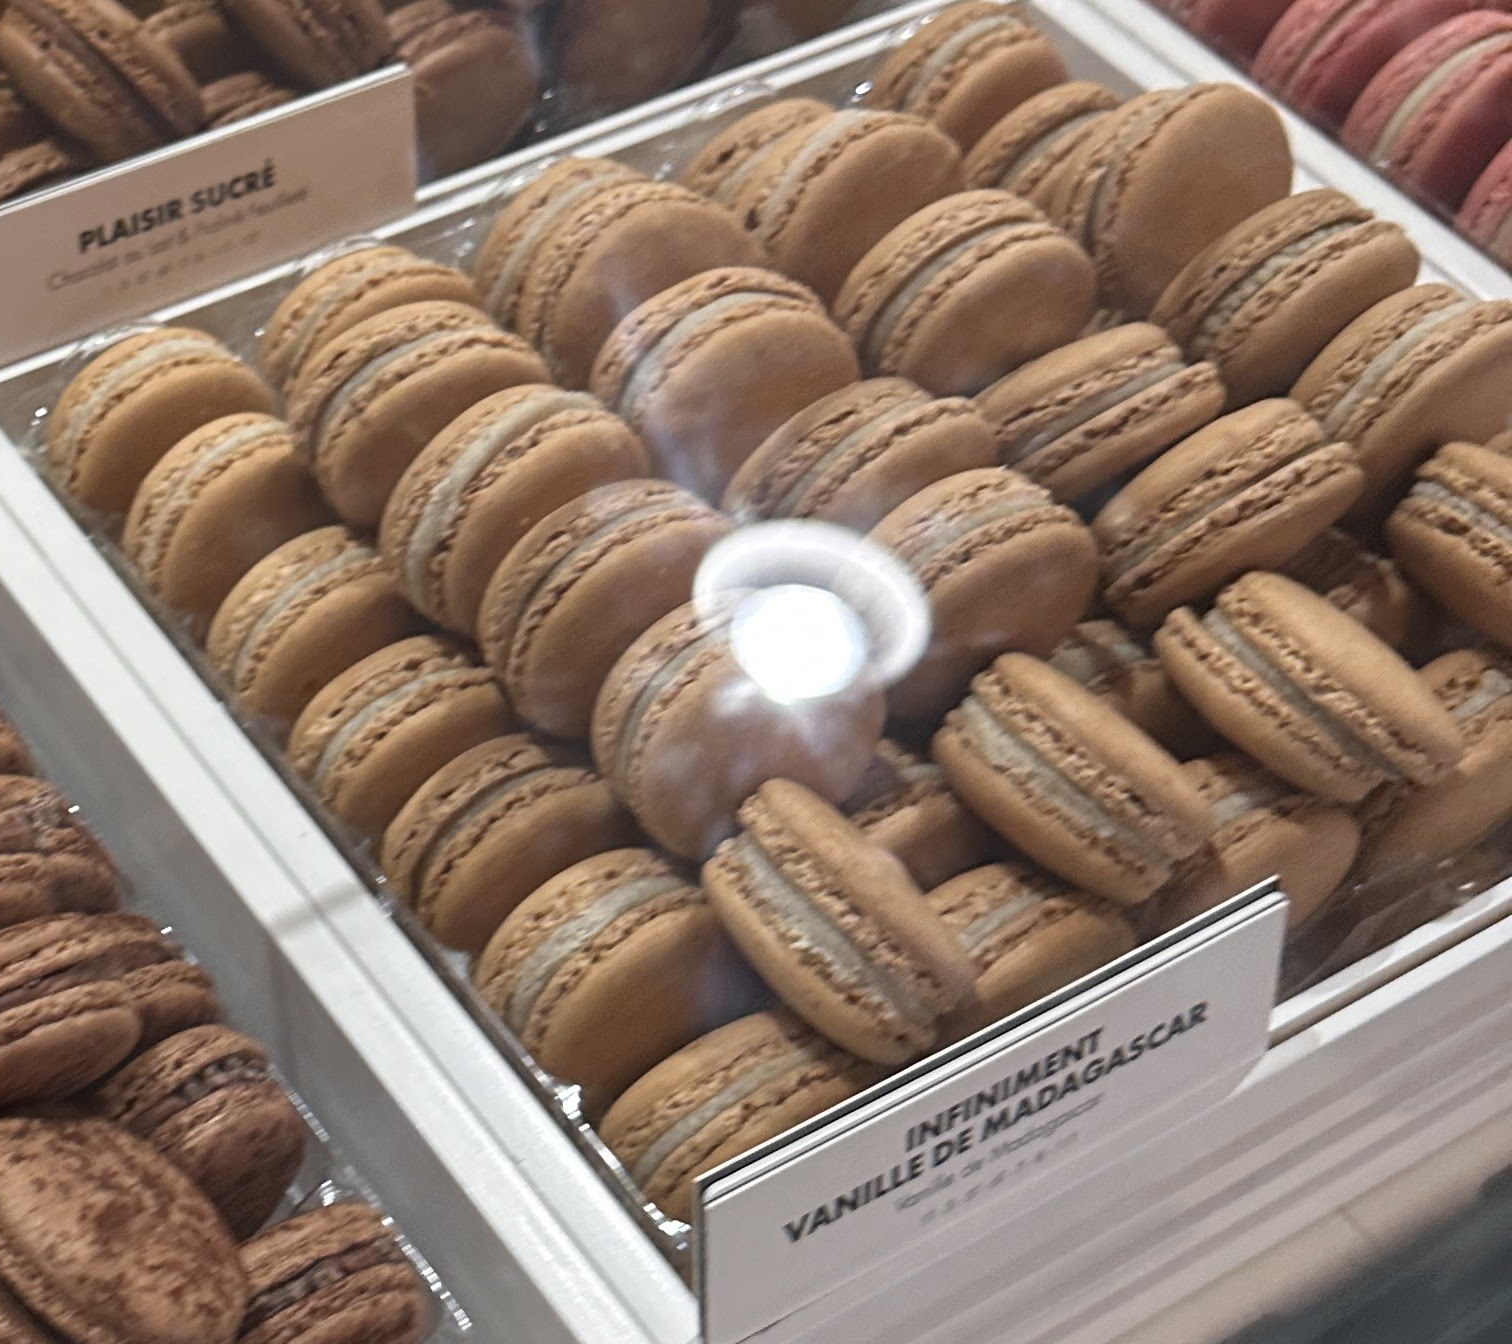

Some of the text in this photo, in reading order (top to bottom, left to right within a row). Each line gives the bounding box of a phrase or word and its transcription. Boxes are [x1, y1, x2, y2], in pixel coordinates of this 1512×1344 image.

[78, 197, 184, 254] PLAISIR
[190, 156, 276, 214] SUCRÉ
[781, 1154, 926, 1244] VANILLE
[931, 1130, 974, 1169] DE
[979, 1001, 1209, 1141] MADAGASCAR
[905, 1026, 1105, 1152] INFINIMENT
